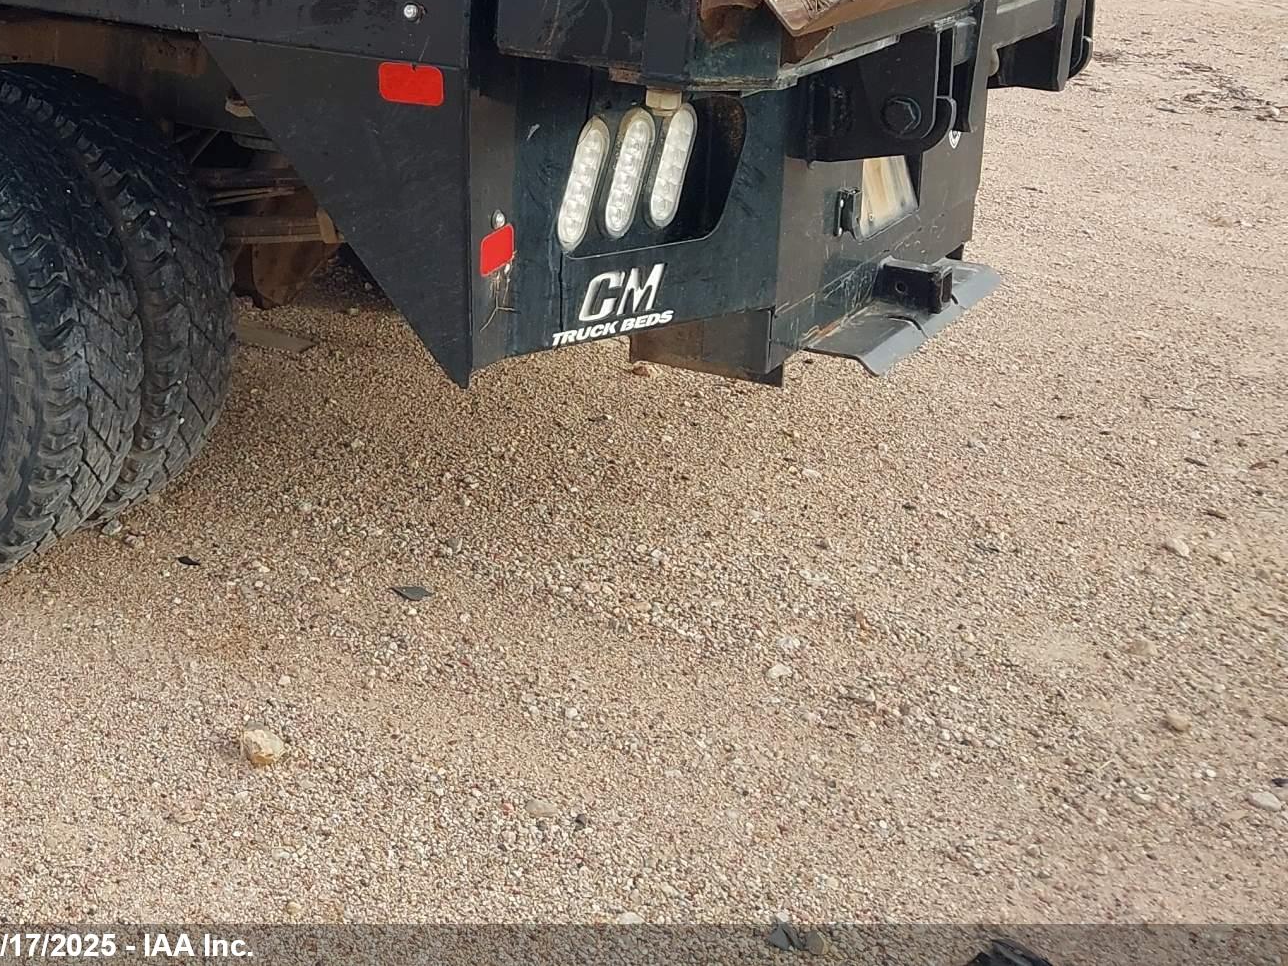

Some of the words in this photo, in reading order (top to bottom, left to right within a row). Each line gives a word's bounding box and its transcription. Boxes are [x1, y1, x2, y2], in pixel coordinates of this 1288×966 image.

[578, 262, 666, 322] CM
[551, 320, 620, 347] TRUCK
[619, 310, 675, 333] BEDS
